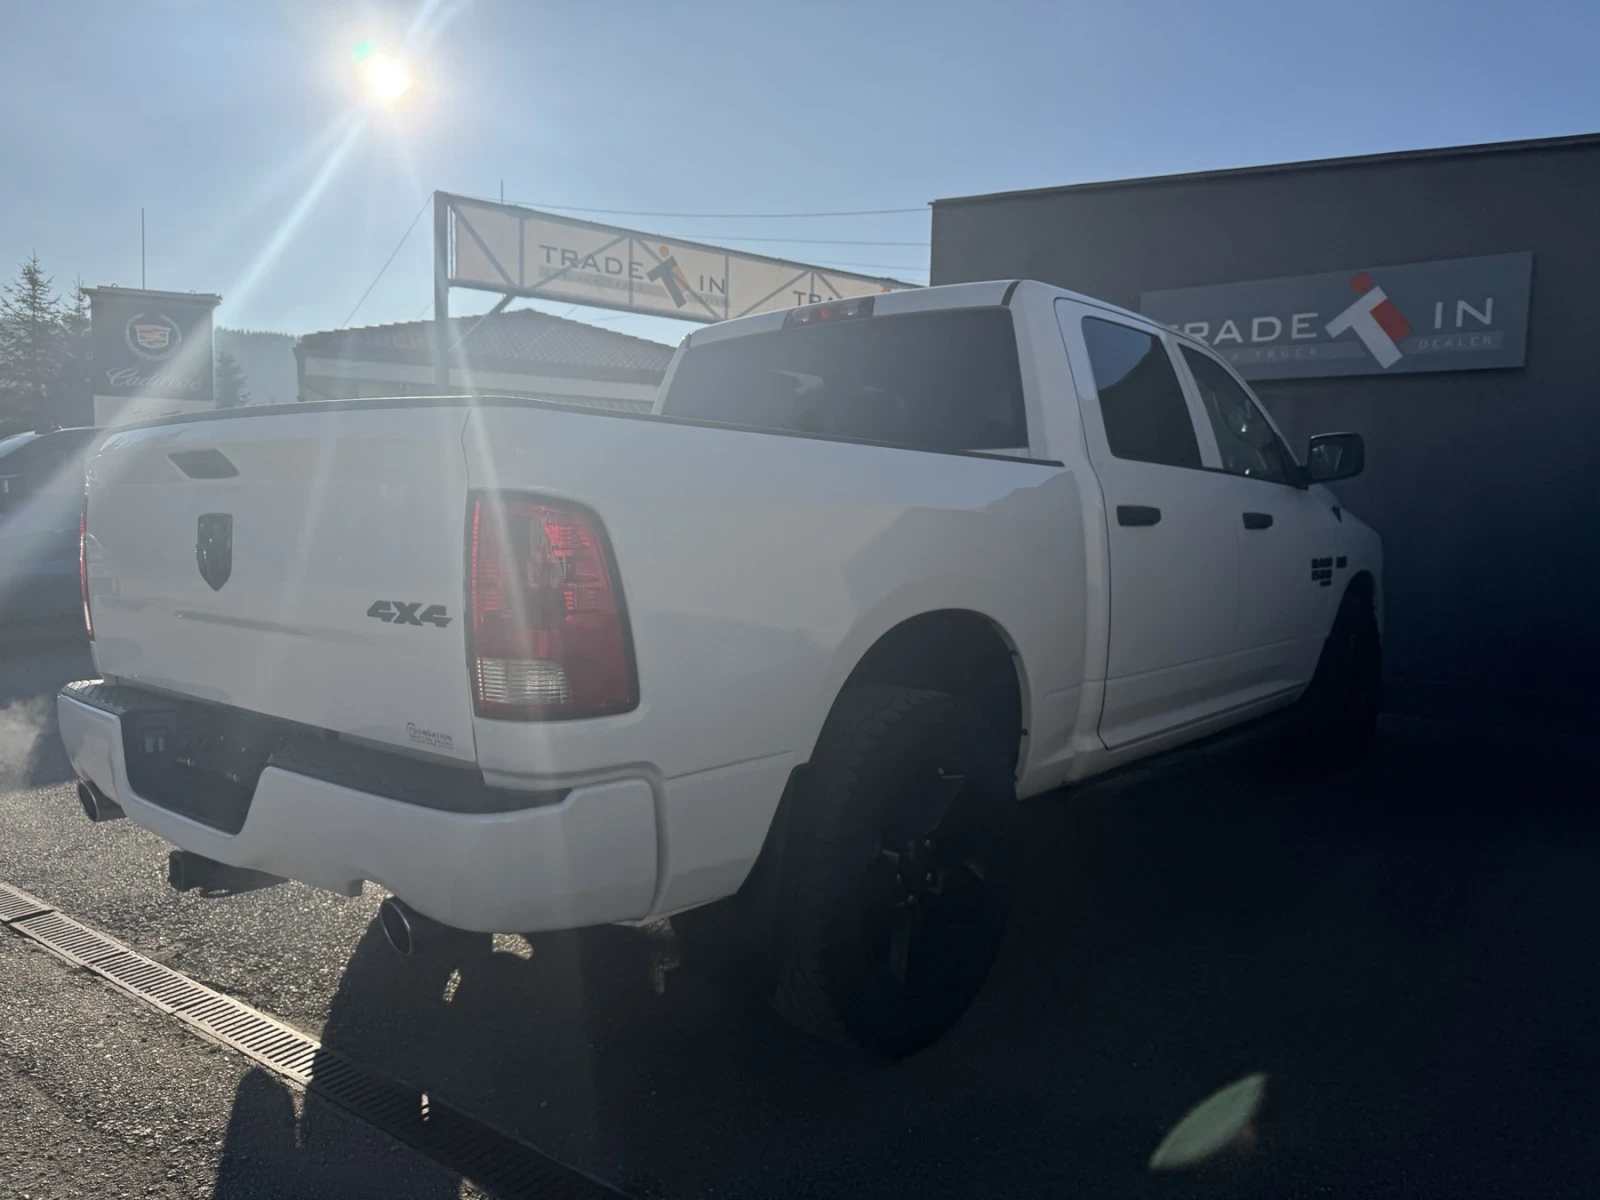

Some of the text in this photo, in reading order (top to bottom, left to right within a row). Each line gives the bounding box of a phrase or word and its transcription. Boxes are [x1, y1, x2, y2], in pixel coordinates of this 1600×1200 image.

[538, 244, 644, 280] TRADE
[699, 274, 726, 295] IN
[1170, 311, 1320, 346] RADE
[1433, 296, 1495, 330] IN
[1417, 336, 1493, 351] DEALER
